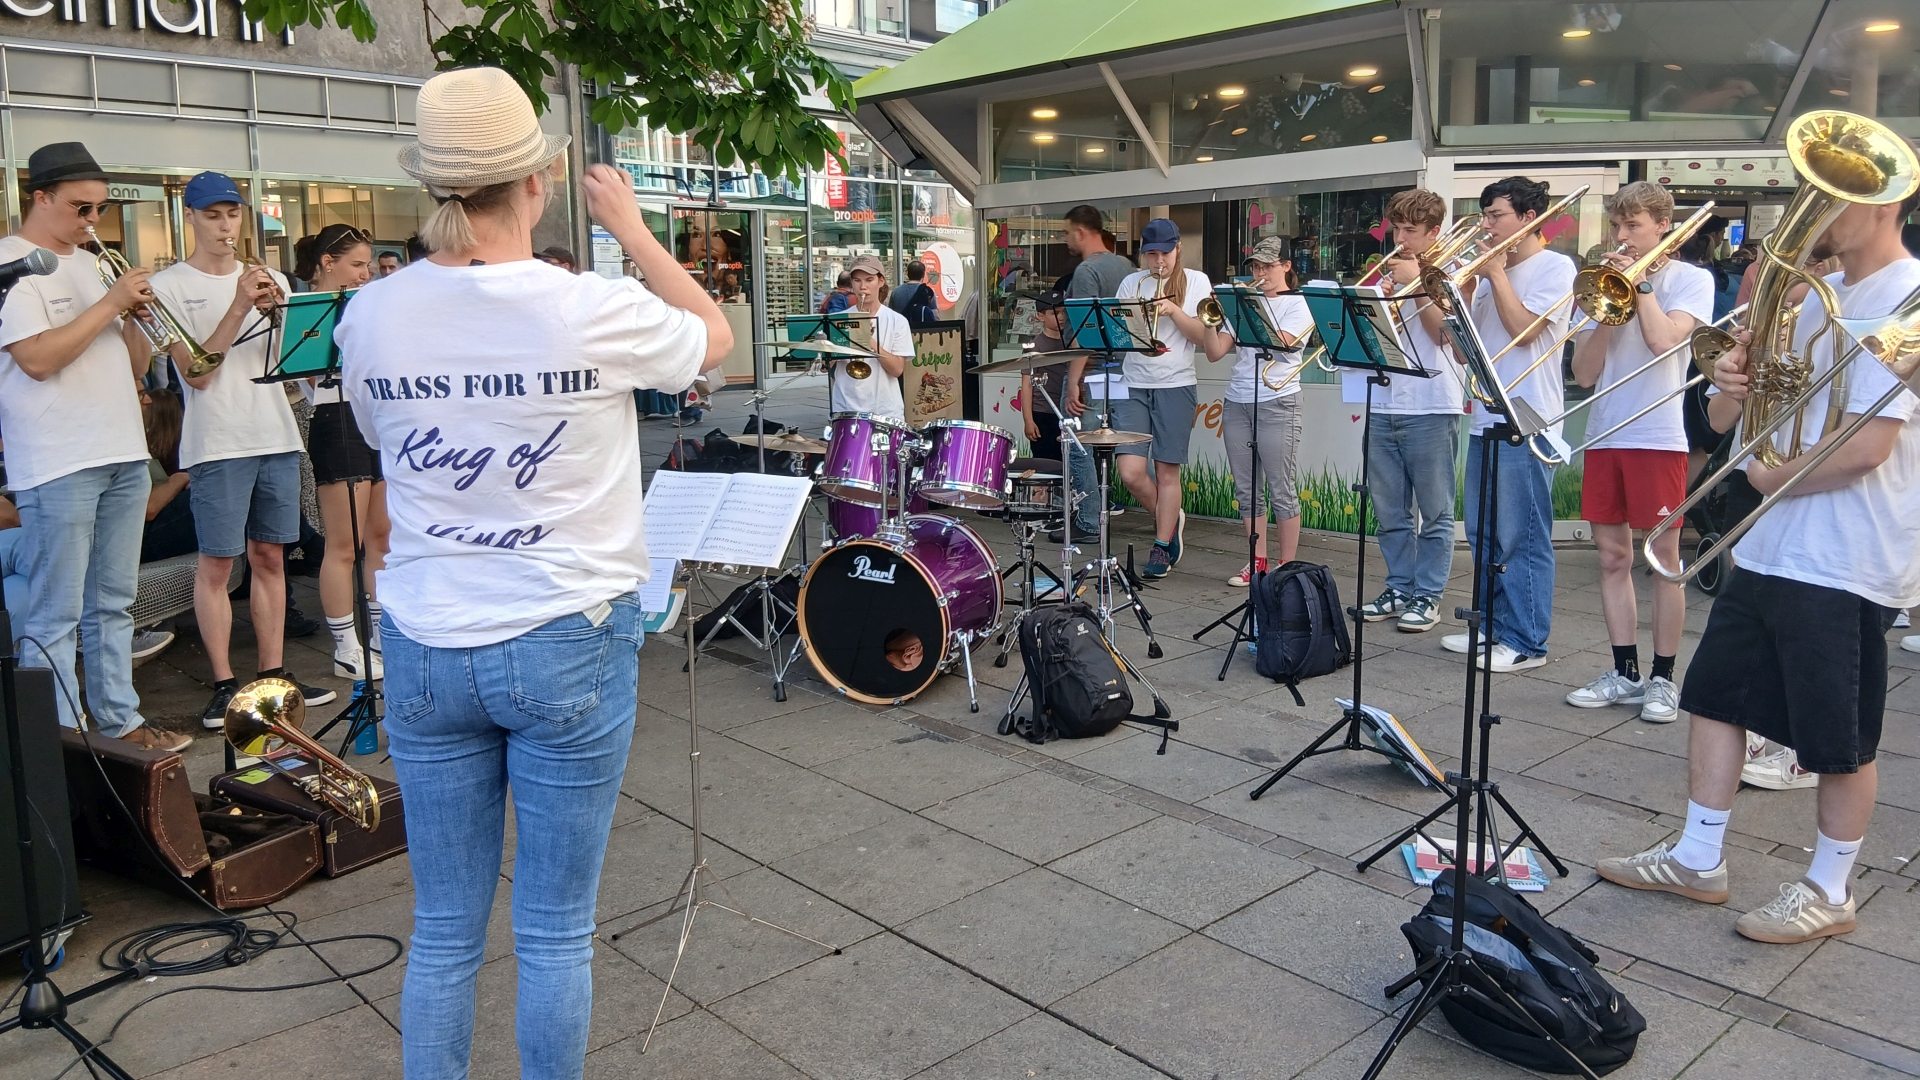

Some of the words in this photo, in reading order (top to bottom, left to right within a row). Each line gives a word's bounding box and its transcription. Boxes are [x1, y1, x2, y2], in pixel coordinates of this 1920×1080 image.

[912, 341, 952, 372] Crêpes
[464, 373, 526, 398] FOR
[537, 368, 600, 395] THE
[396, 426, 496, 491] King
[507, 420, 567, 490] of
[847, 555, 897, 582] Pearl
